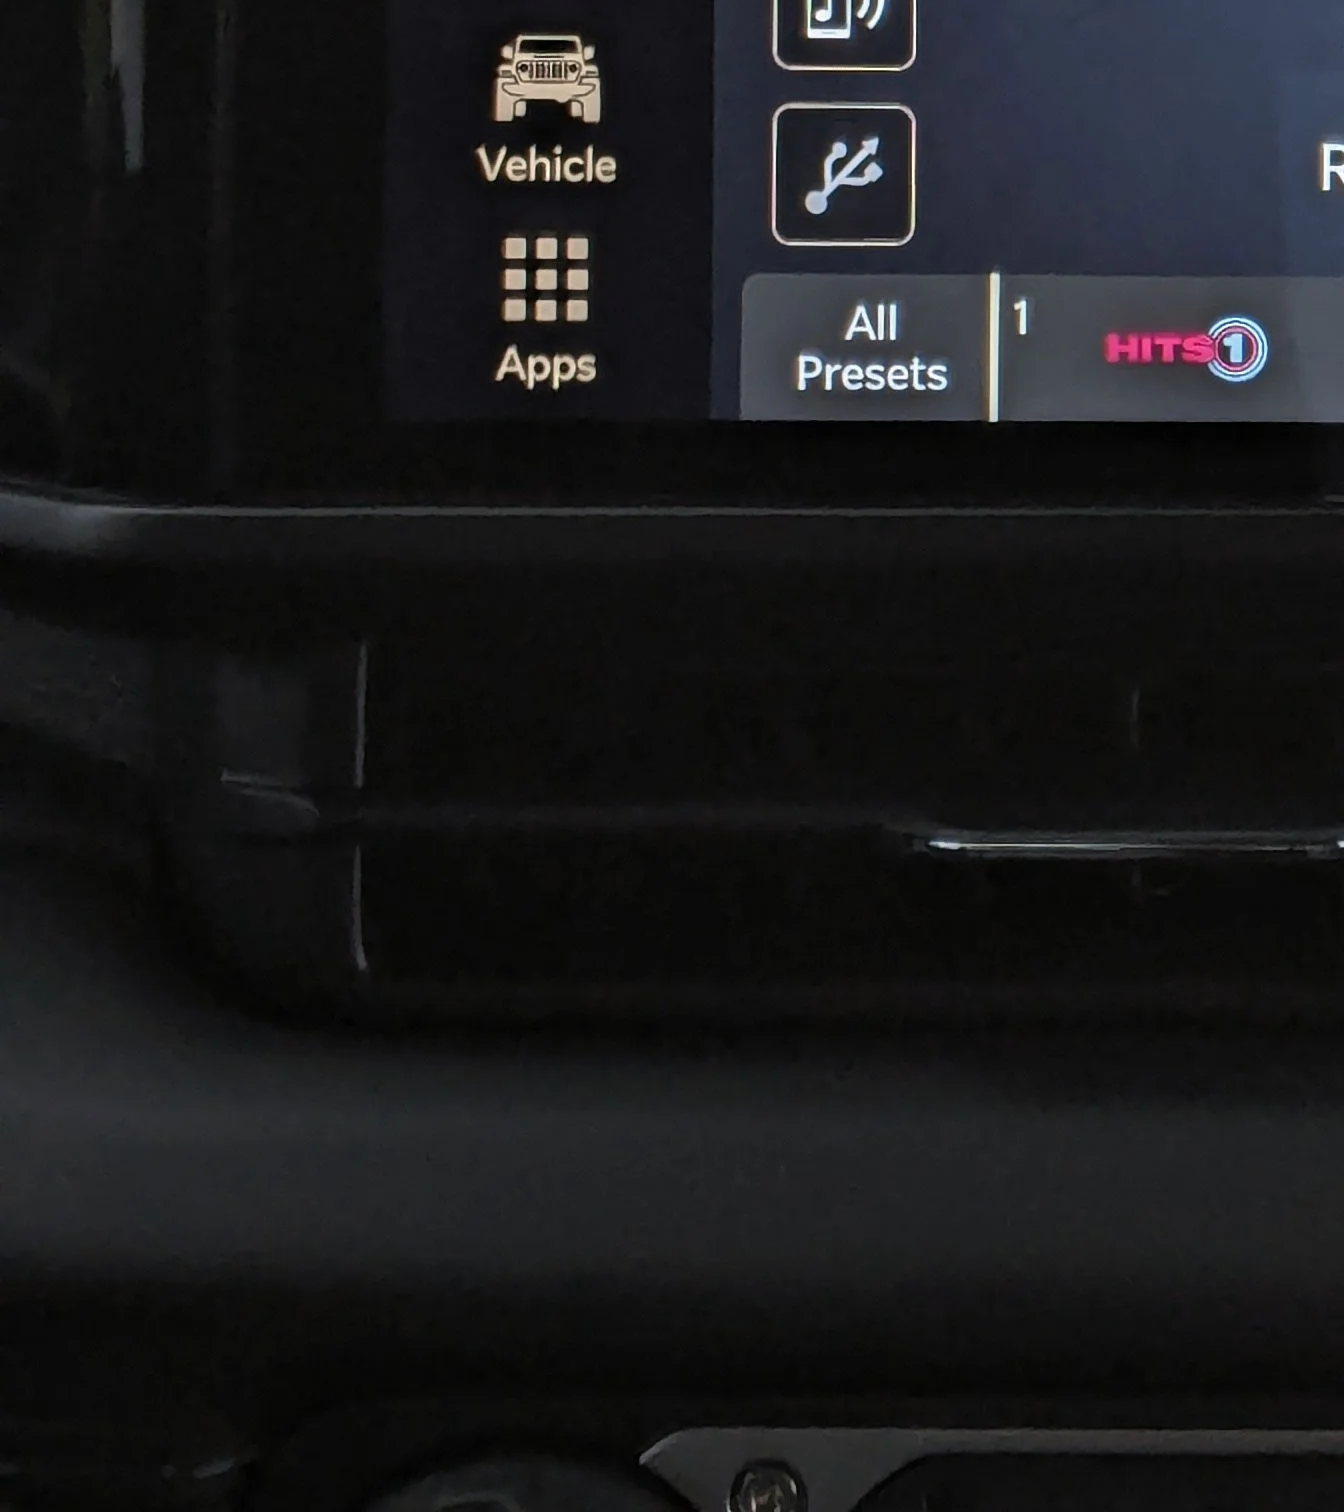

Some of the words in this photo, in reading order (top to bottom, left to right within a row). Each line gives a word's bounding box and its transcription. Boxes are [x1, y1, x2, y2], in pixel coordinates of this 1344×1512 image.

[476, 146, 618, 184] Vehicle
[843, 304, 898, 342] All
[1013, 299, 1029, 336] 1
[495, 345, 598, 391] Apps
[797, 356, 949, 391] Presets
